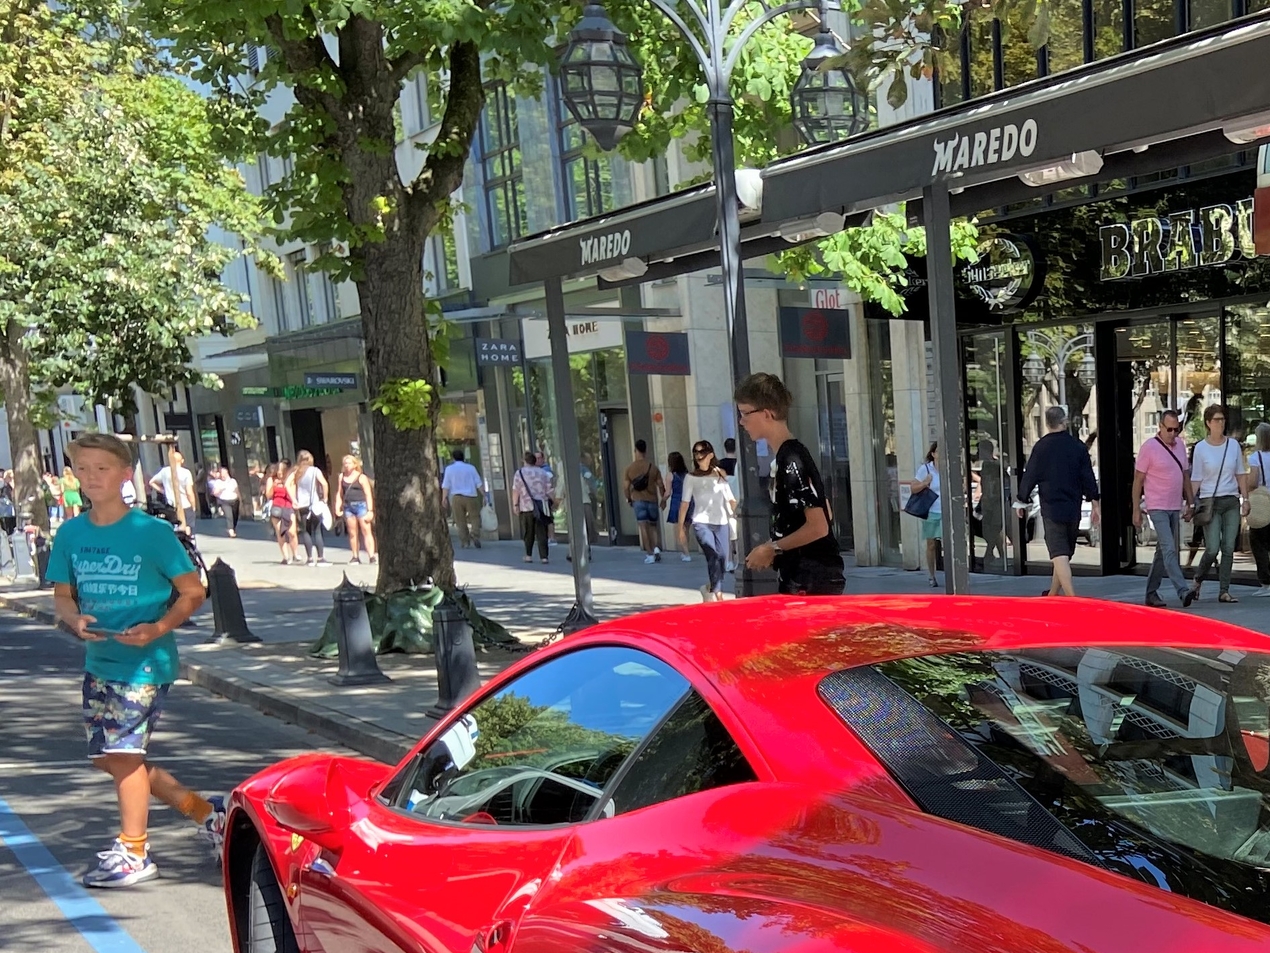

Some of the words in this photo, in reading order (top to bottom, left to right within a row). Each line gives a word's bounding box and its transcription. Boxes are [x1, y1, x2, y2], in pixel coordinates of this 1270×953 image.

[931, 118, 1038, 177] MAREDO
[579, 229, 631, 266] MAREDO
[572, 321, 599, 336] HOME
[481, 343, 517, 352] ZARA
[481, 353, 519, 363] HOME
